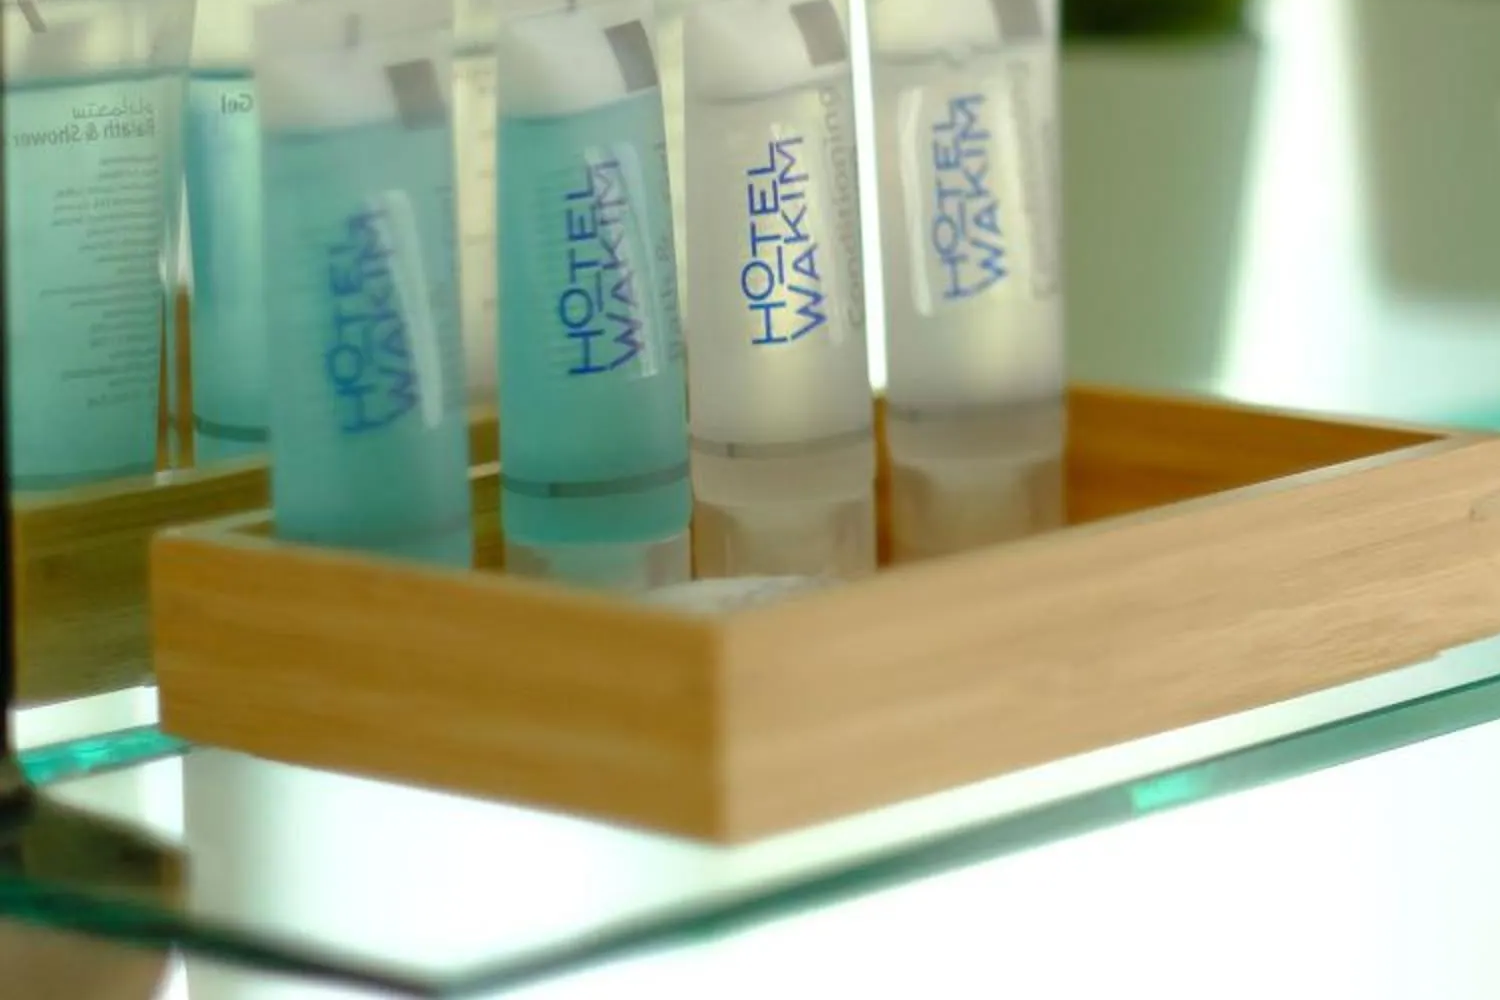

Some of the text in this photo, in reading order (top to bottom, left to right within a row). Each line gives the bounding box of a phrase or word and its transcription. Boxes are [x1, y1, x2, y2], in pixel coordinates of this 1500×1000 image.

[558, 163, 608, 376] HOTEL
[594, 159, 645, 371] WAKIM
[740, 140, 788, 346] HOTEL
[775, 136, 828, 341] WAKIM
[932, 99, 972, 299] HOTEL
[951, 94, 1008, 295] WAKIM
[324, 214, 379, 435] HOTEL
